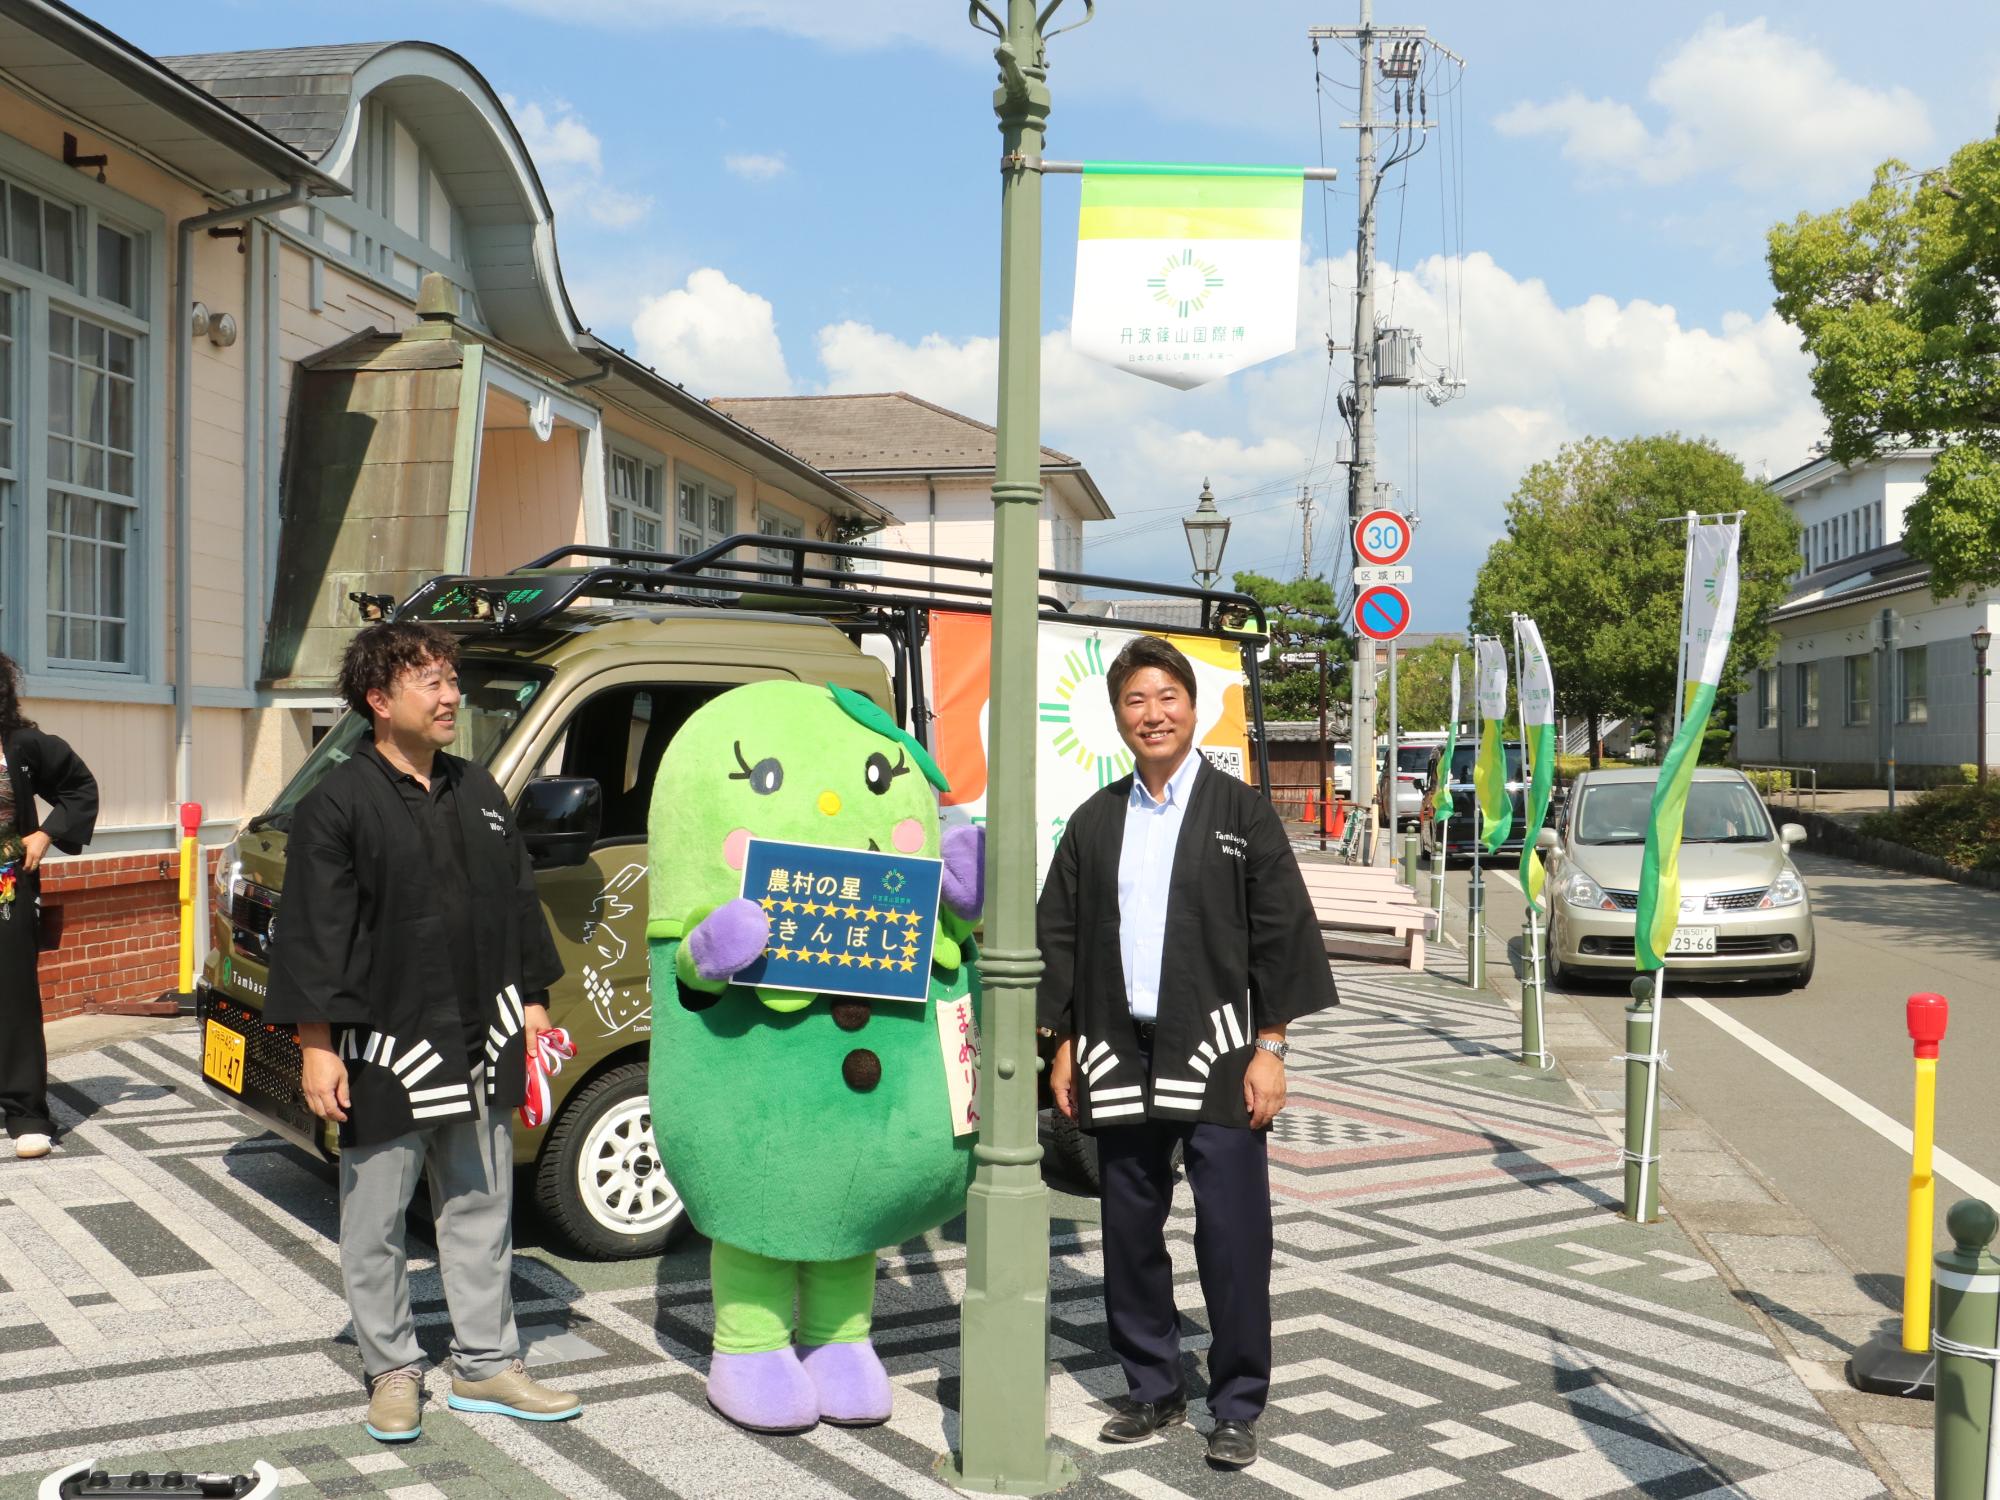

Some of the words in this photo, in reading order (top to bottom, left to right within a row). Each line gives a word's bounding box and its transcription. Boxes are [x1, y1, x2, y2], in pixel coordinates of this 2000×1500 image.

[1120, 326, 1245, 345] 丹波篠山国際博
[1368, 525, 1398, 549] 30
[1361, 570, 1405, 581] 区域内
[767, 868, 861, 901] 農村の星
[779, 918, 898, 950] きんぼし
[1674, 937, 1713, 950] 29-66
[957, 1003, 980, 1124] まめりん
